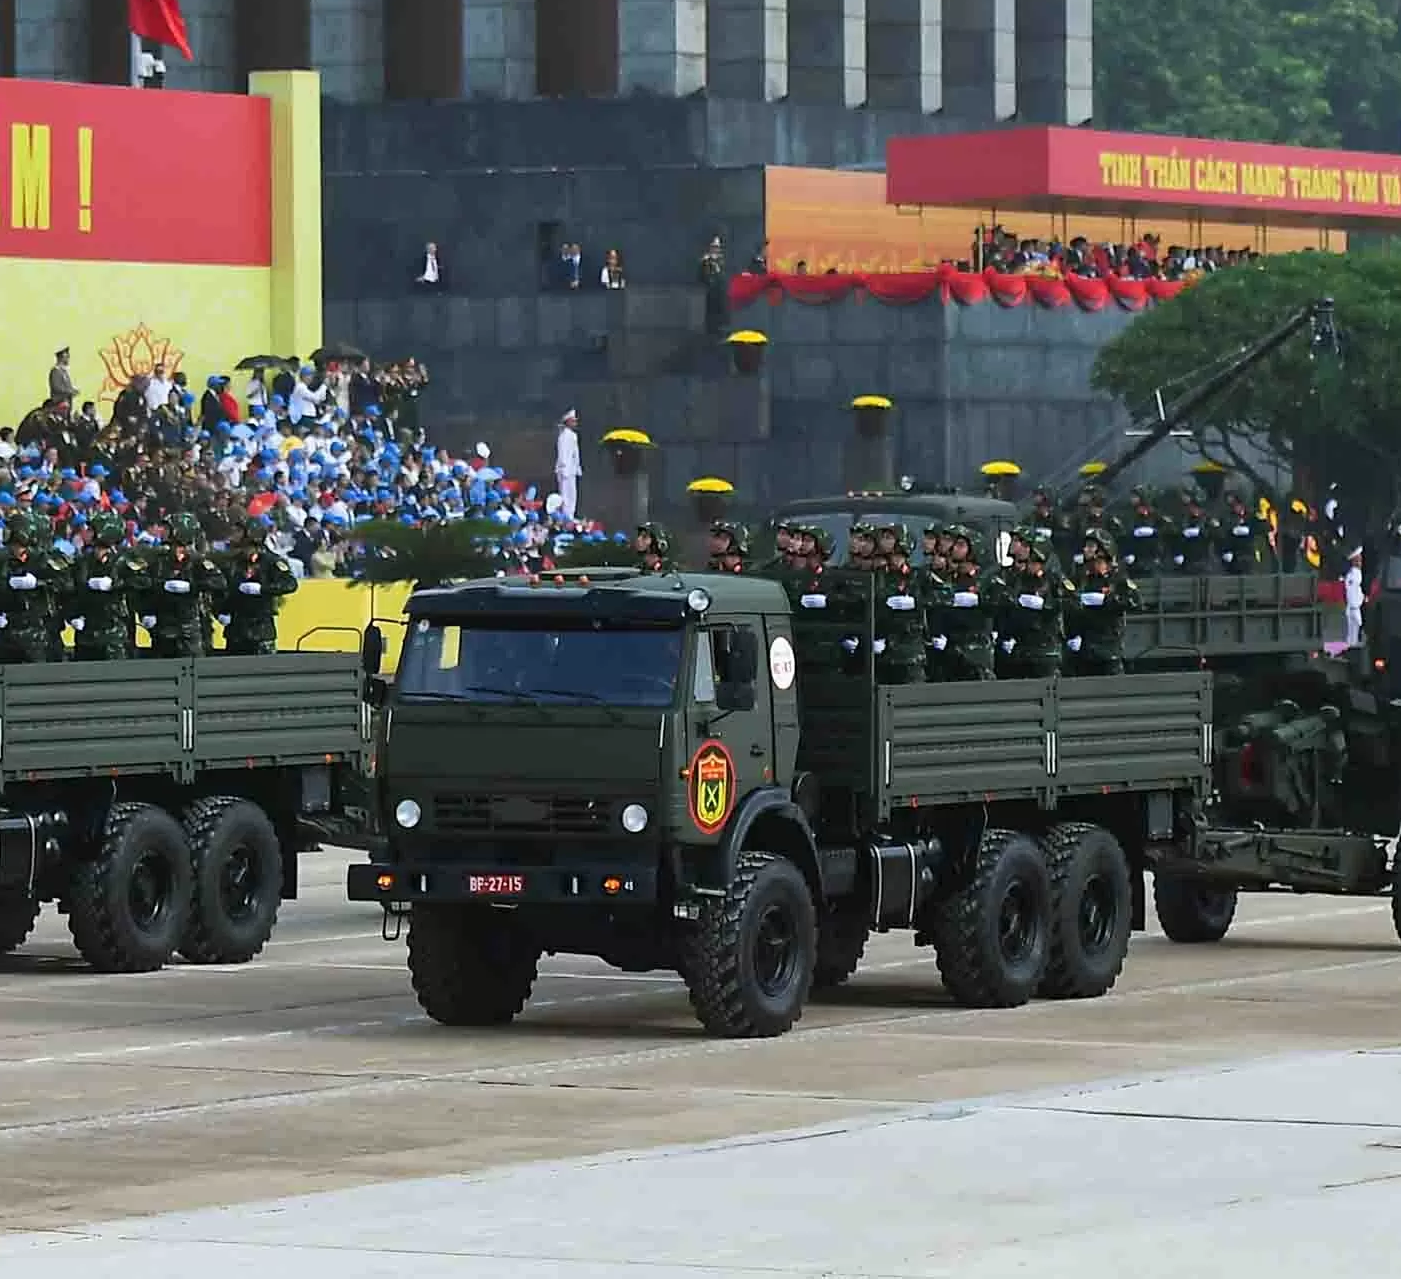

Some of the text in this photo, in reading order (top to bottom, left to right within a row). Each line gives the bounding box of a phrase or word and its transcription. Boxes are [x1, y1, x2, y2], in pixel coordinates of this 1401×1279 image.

[1100, 152, 1142, 187] TINH
[1195, 153, 1237, 194] CÁCH
[1241, 162, 1286, 202] MẠNG
[1289, 165, 1342, 201] THÁNG
[469, 876, 522, 892] BP-27-15
